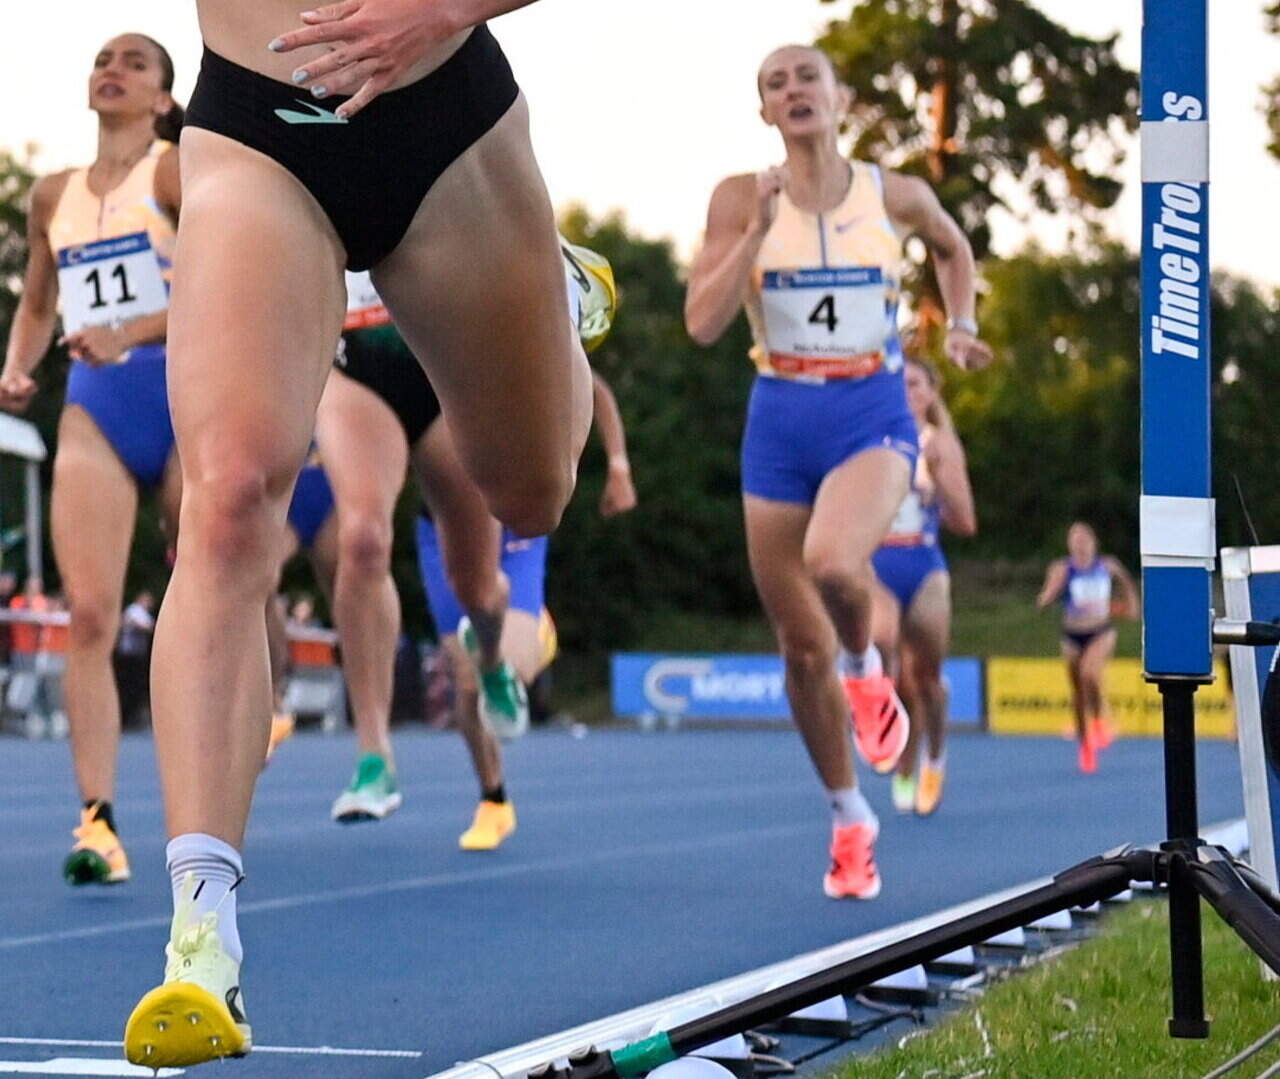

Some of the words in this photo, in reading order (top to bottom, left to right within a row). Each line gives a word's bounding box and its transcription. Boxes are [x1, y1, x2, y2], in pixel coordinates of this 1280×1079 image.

[1151, 91, 1202, 359] TimeTros
[85, 263, 137, 309] 11
[808, 293, 838, 333] 4
